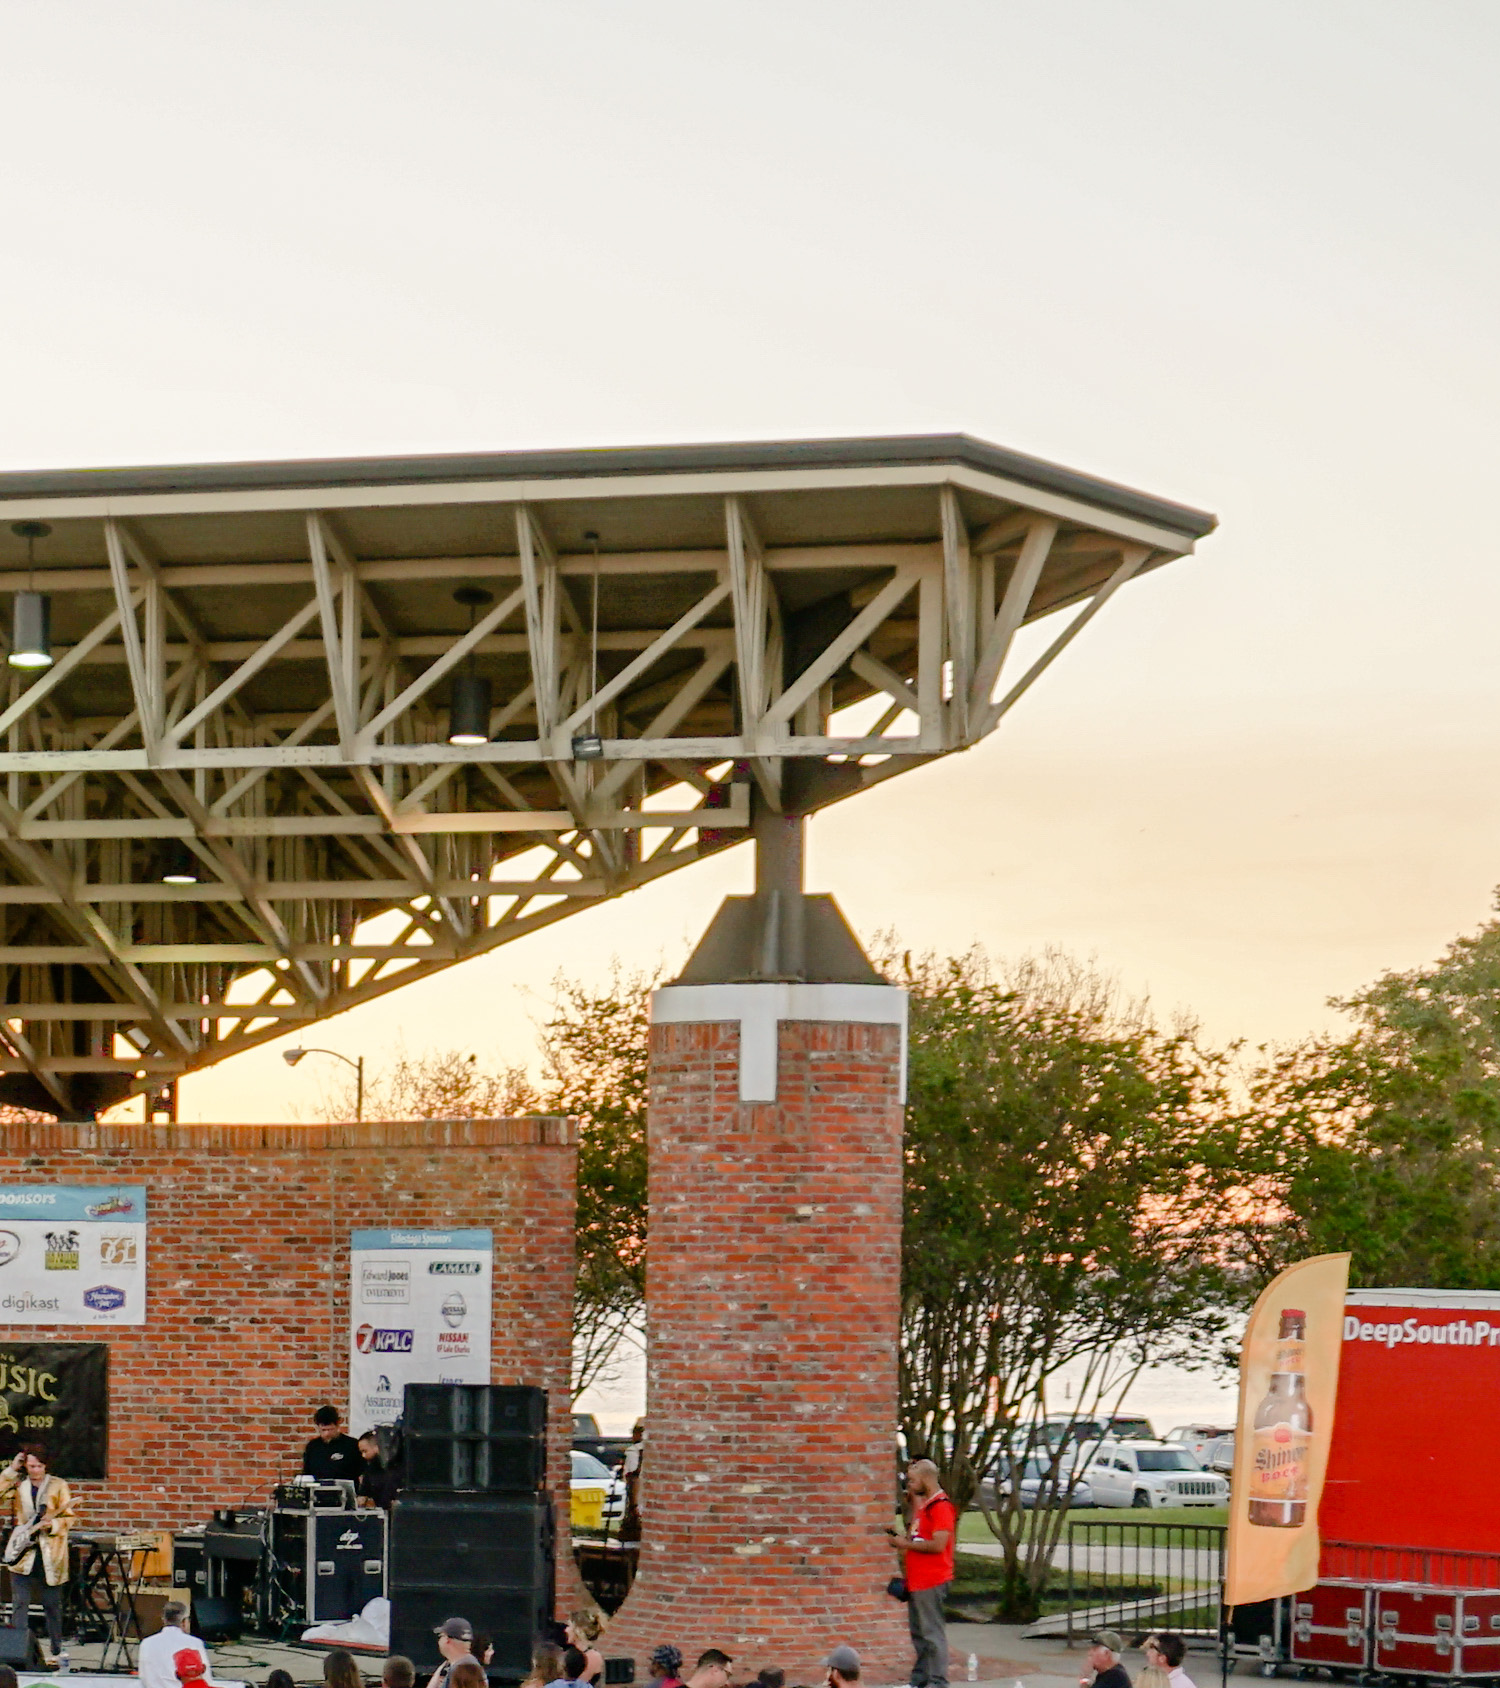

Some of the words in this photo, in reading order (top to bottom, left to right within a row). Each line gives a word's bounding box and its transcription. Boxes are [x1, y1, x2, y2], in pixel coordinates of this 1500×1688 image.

[2, 1295, 60, 1312] digikast
[375, 1331, 413, 1351] KPLC
[438, 1332, 470, 1343] NISSAN
[364, 1394, 404, 1408] Assuran
[24, 1414, 54, 1428] 1909
